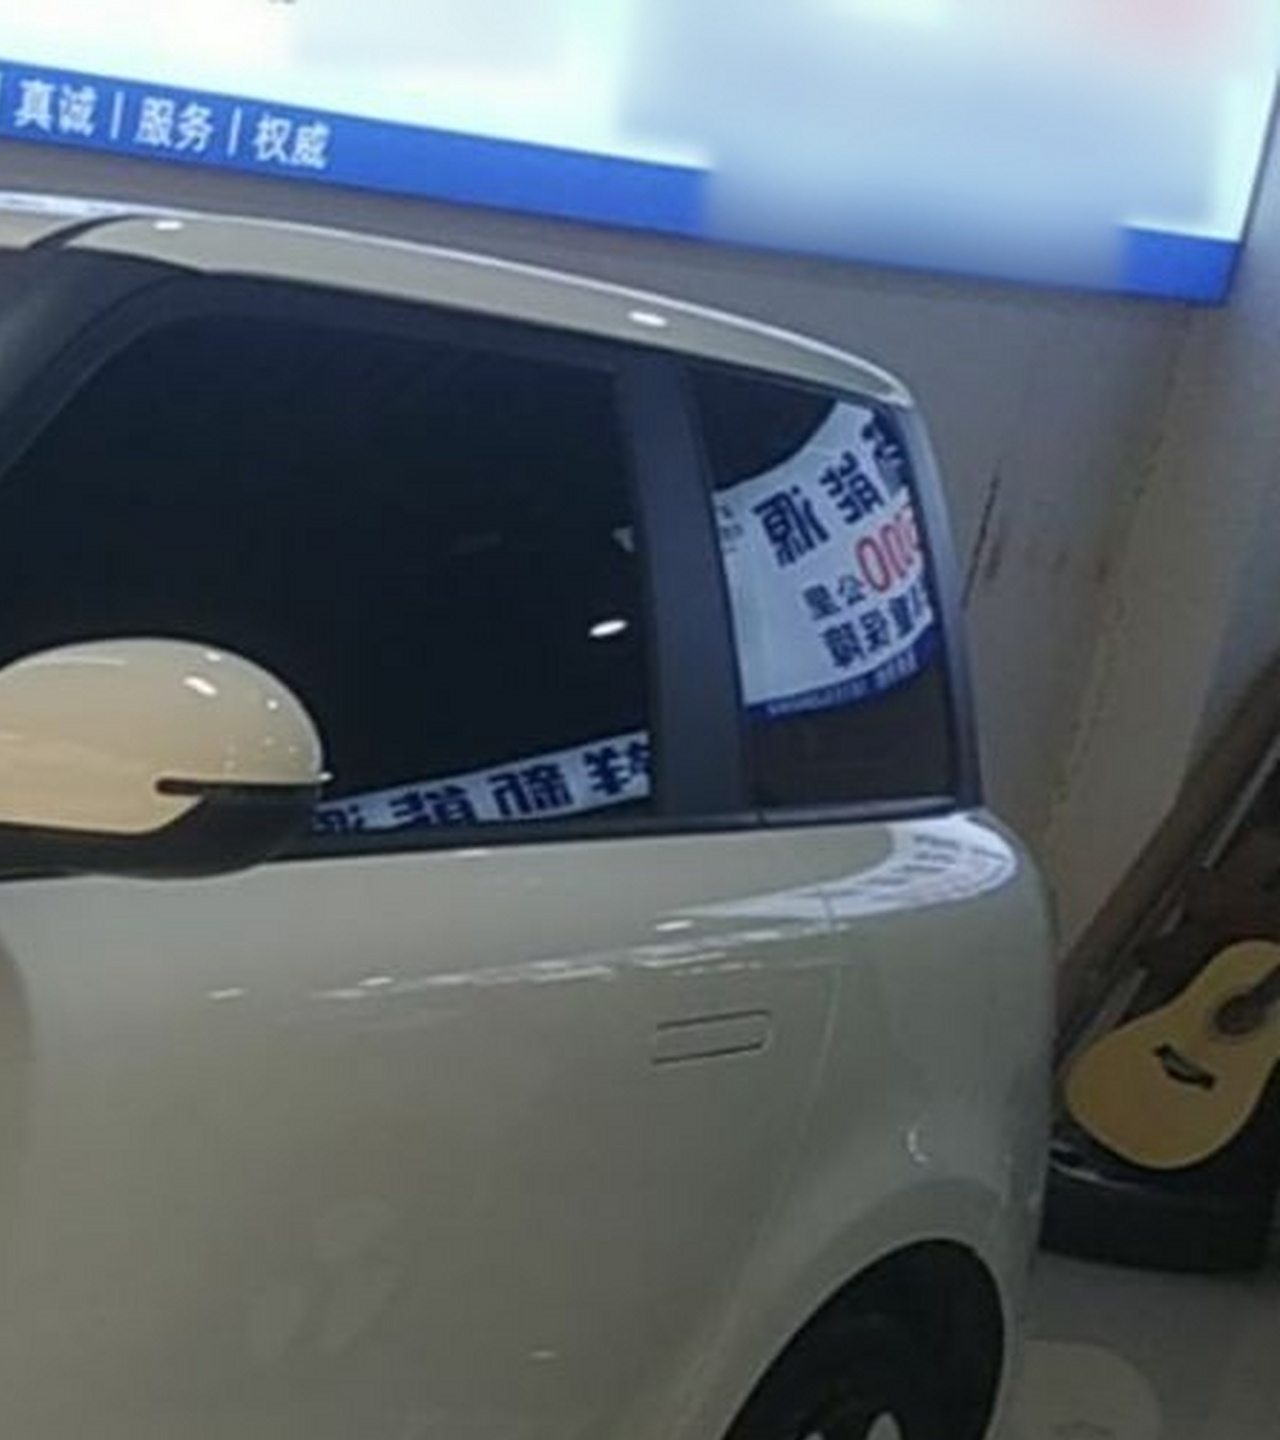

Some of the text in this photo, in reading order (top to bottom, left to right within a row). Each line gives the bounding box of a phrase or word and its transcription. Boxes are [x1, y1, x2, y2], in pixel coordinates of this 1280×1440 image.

[14, 78, 96, 137] 真诚
[135, 96, 214, 154] 服务
[253, 111, 331, 169] 权威
